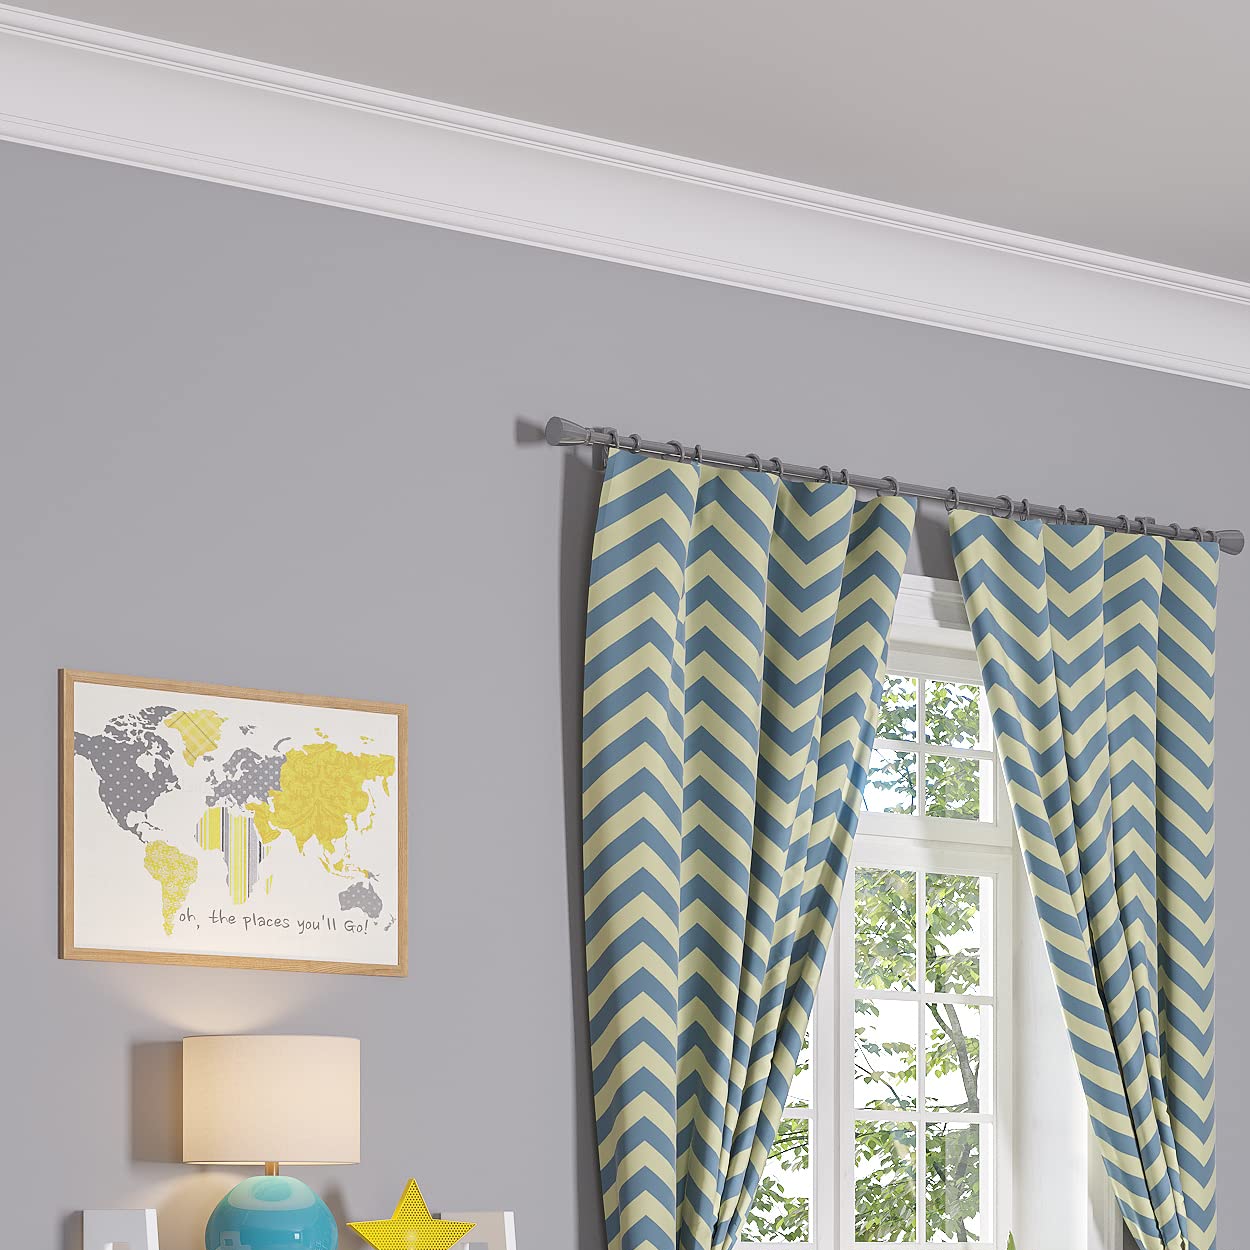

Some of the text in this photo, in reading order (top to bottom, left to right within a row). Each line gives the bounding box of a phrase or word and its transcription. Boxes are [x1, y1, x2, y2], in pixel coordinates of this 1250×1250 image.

[179, 907, 369, 935] oh, the places you'll Go!
